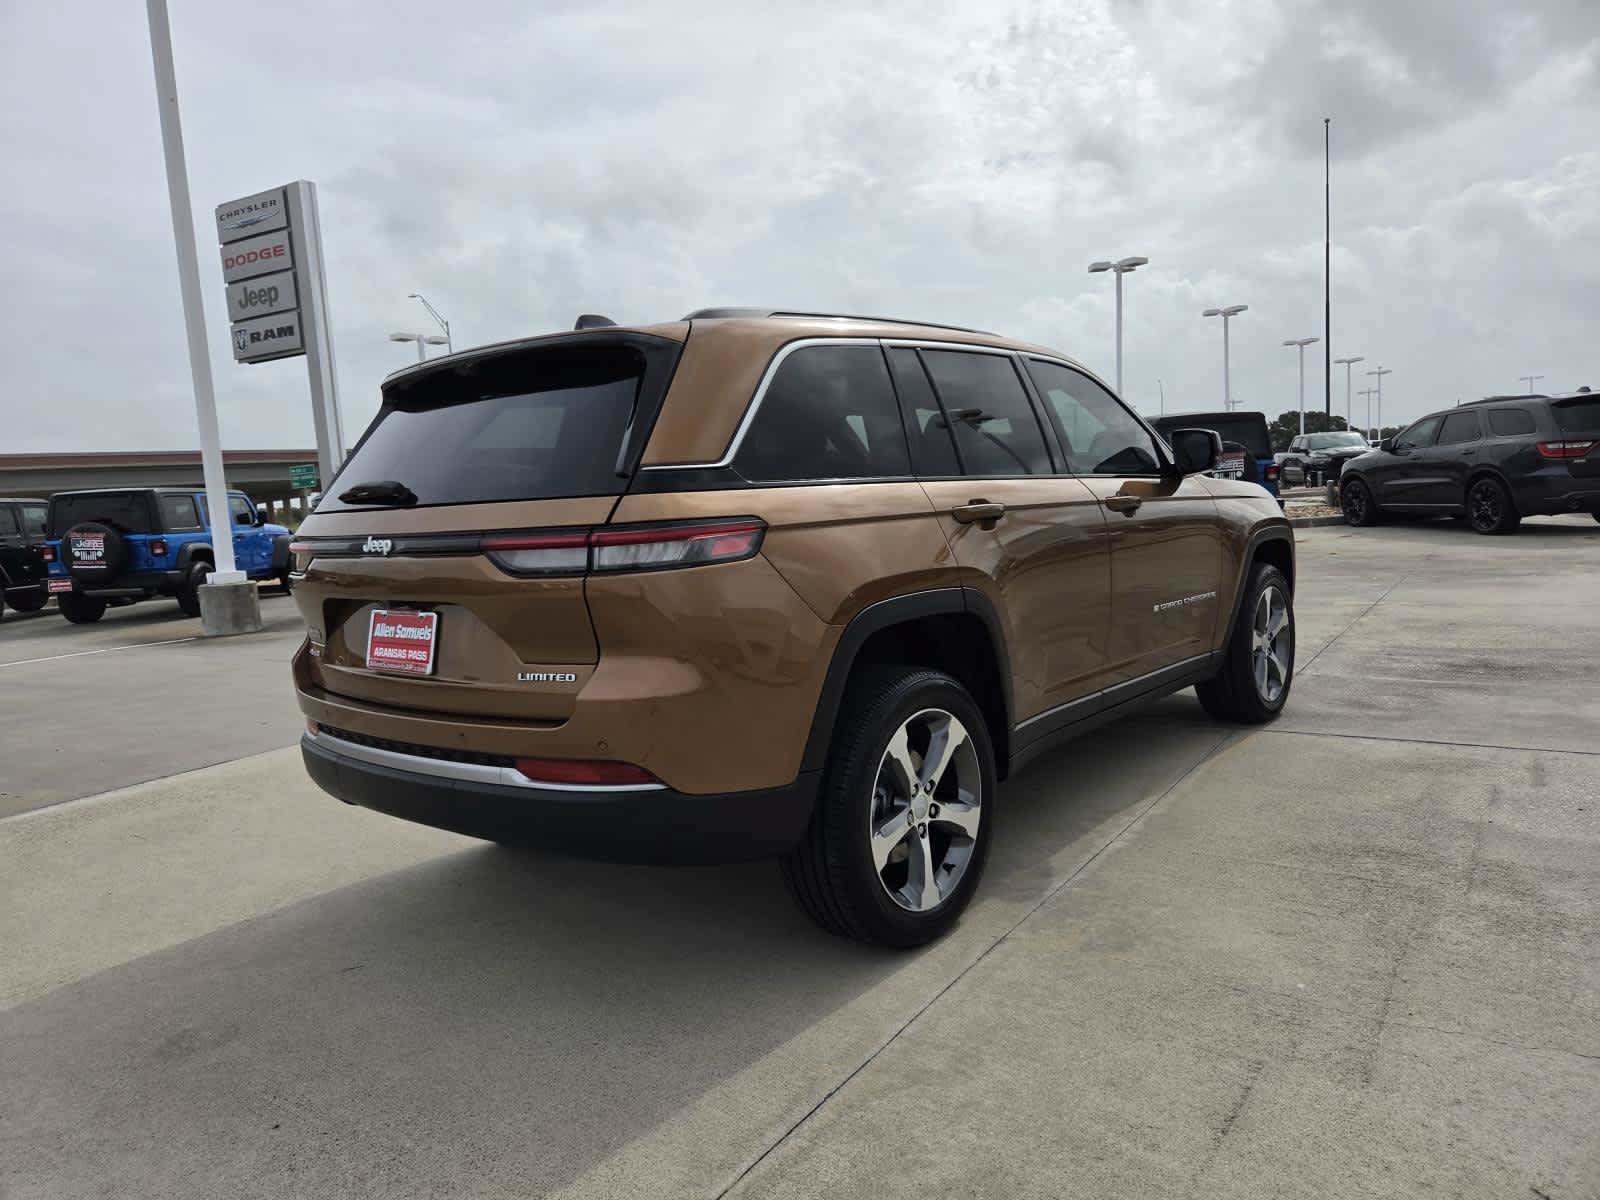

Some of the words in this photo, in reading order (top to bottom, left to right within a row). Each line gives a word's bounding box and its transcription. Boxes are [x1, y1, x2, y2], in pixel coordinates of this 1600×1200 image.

[219, 199, 278, 222] CHRYSLER
[224, 244, 285, 270] DODGE
[238, 285, 280, 309] Jeep
[250, 324, 295, 344] RAM
[362, 536, 392, 555] Jeep
[374, 622, 396, 638] Allen
[395, 624, 432, 640] Samuels
[373, 646, 407, 659] ARANSAS
[407, 649, 428, 661] PASS
[517, 672, 577, 682] LIMITED
